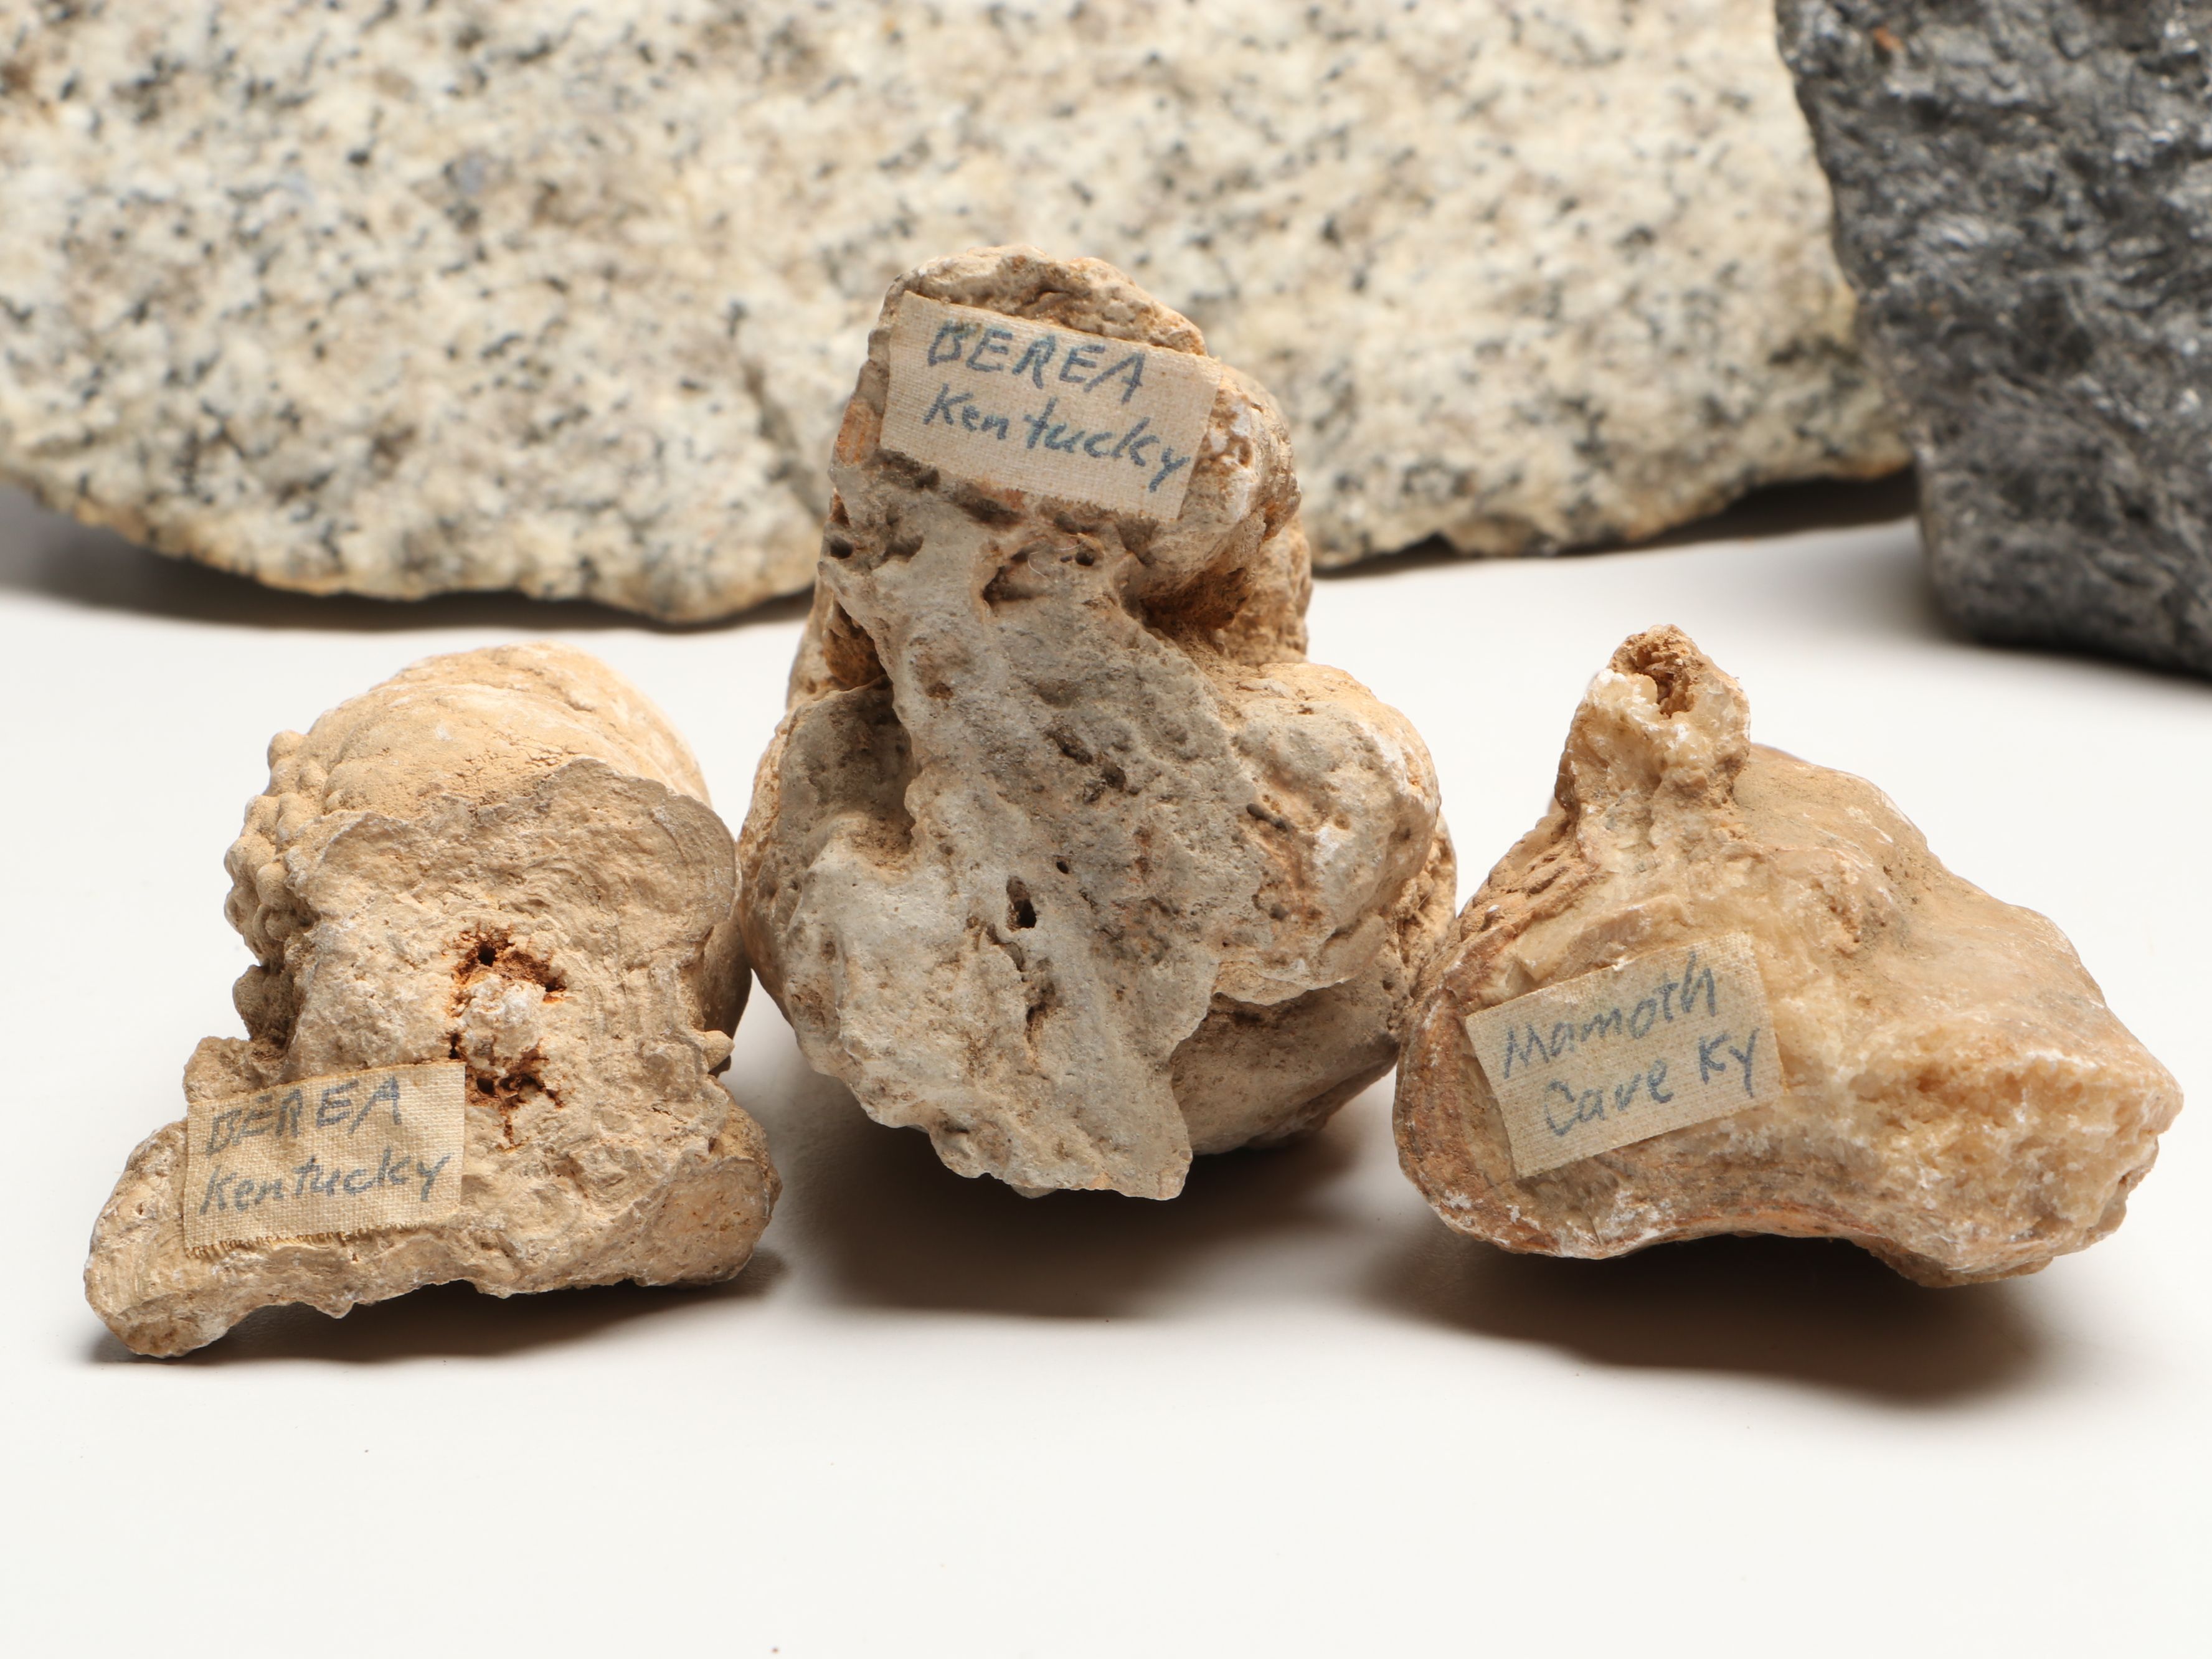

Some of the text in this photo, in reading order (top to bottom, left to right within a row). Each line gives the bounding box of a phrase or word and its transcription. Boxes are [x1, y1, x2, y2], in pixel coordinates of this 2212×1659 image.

[928, 319, 1146, 404] BEREA
[923, 383, 1190, 493] Kentucky
[1503, 950, 1716, 1079] Mamoth
[206, 1075, 402, 1157] BEREA
[1544, 1059, 1674, 1137] Cave
[200, 1145, 453, 1214] Kentucky
